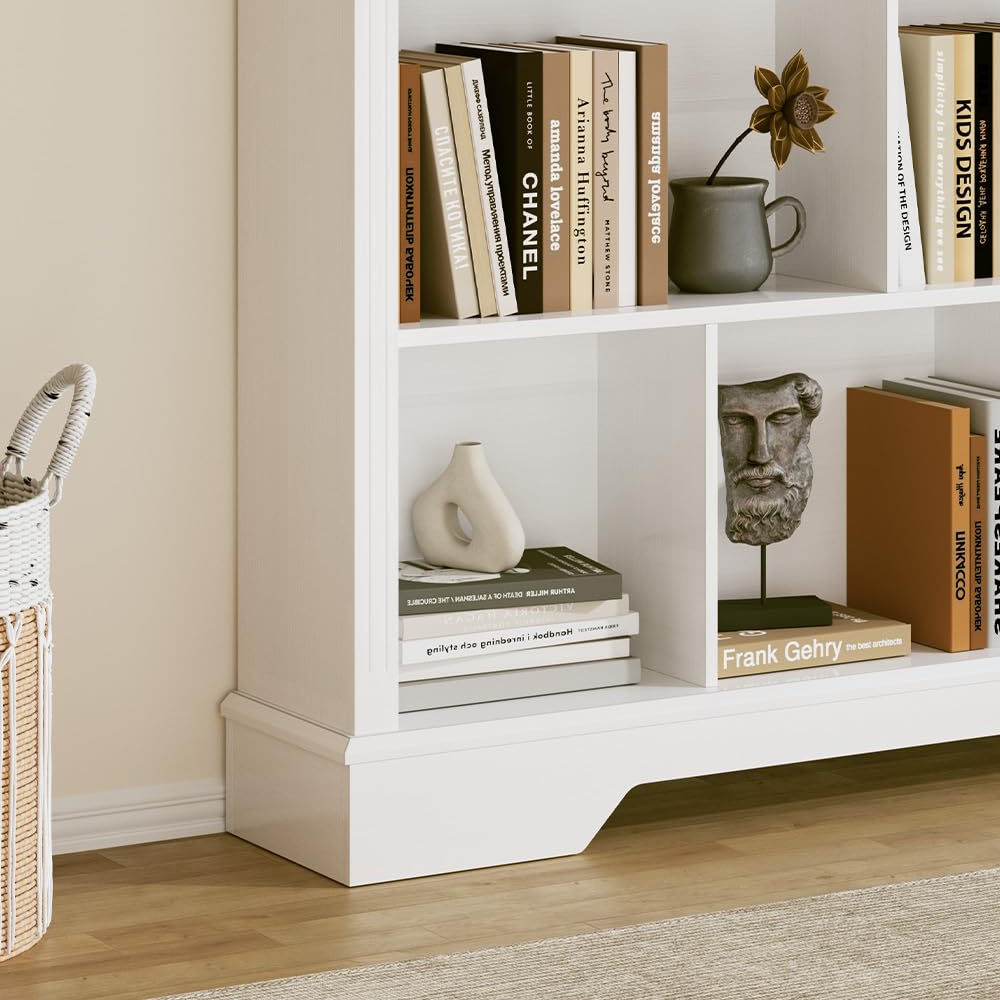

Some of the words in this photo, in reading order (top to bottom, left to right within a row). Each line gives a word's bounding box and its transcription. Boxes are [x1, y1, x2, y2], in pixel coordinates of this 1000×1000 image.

[935, 50, 945, 116] simplicity
[526, 138, 532, 150] OF
[577, 98, 590, 165] Arianna
[936, 121, 944, 132] is
[936, 137, 944, 149] in
[956, 100, 972, 150] KIDS
[434, 126, 458, 198] СПАСИТЕ
[481, 149, 494, 180] Метод
[550, 119, 564, 182] amanda
[899, 189, 908, 210] THE
[935, 154, 944, 223] everything
[956, 159, 972, 240] DESIGN
[522, 172, 538, 281] CHANEL
[550, 186, 564, 252] lovelace
[574, 172, 590, 266] Huffington
[901, 212, 912, 251] DESIGN
[936, 228, 943, 246] we
[723, 644, 778, 670] Frank
[784, 638, 843, 663] Gehry
[872, 638, 903, 648] architects
